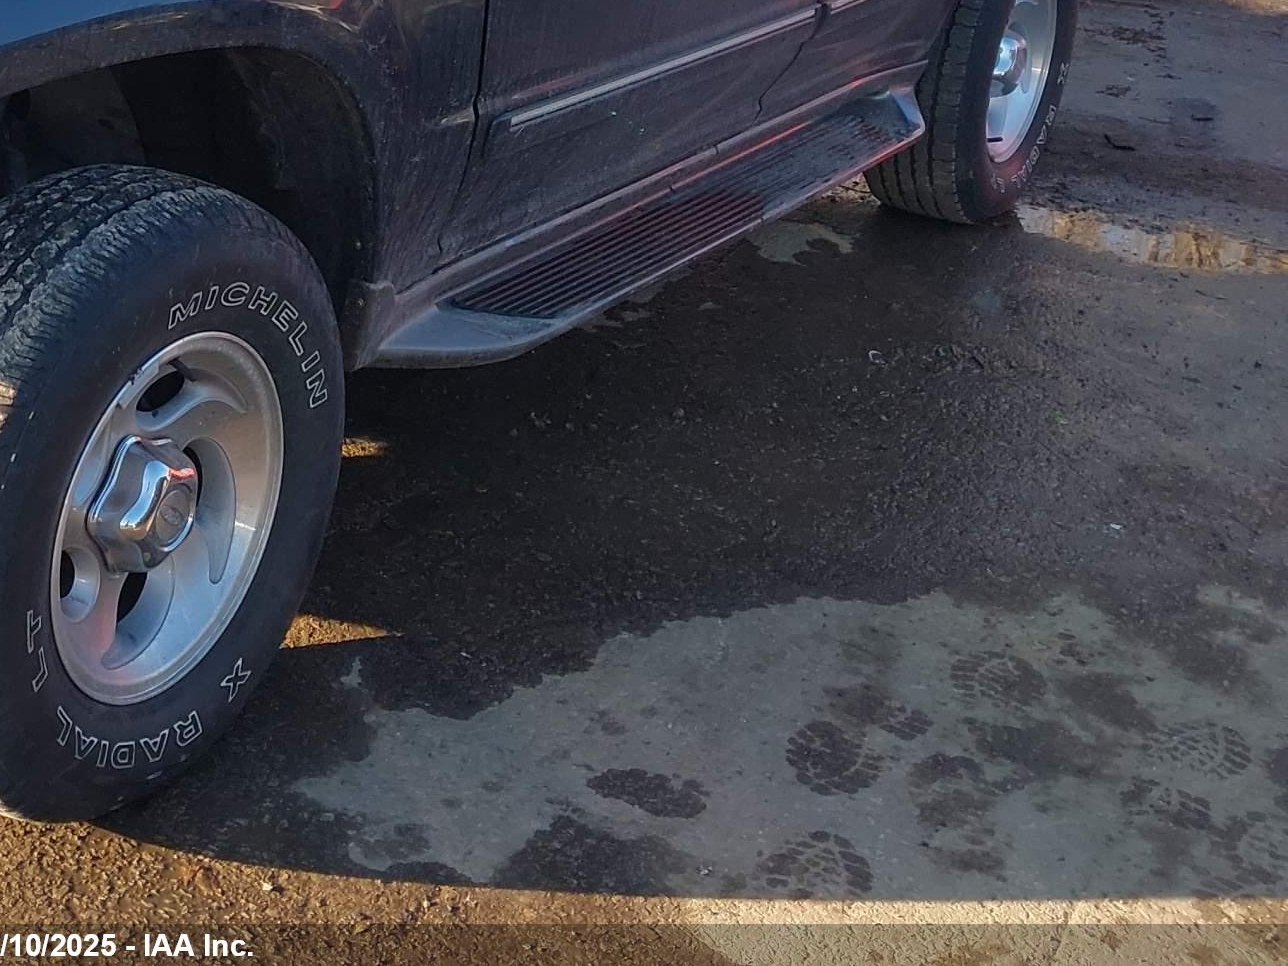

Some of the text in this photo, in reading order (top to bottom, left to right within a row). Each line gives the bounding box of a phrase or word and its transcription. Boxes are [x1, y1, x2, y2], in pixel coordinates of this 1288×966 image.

[168, 282, 328, 408] MICHELIN
[27, 610, 252, 769] X RADIAL LT
